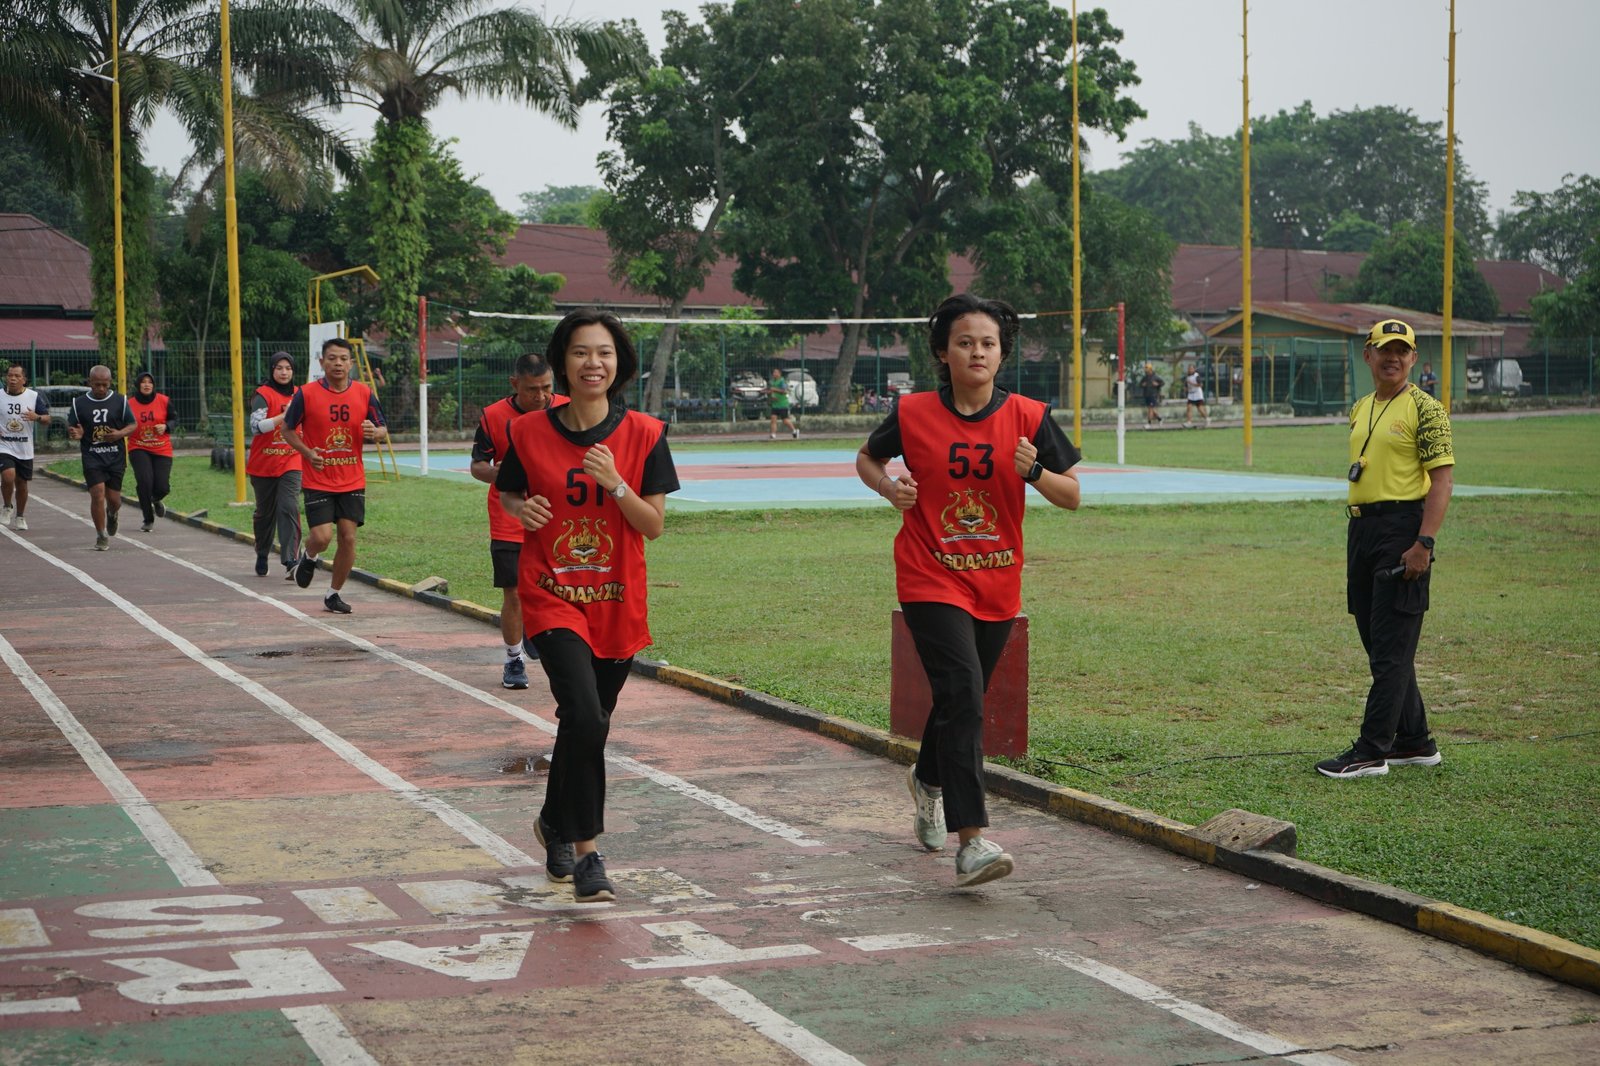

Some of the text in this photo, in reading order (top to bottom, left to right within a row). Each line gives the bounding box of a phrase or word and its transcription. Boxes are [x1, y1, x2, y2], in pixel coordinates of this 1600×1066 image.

[7, 403, 21, 415] 39
[92, 408, 109, 423] 27
[330, 404, 350, 422] 56
[140, 411, 155, 423] 54
[948, 442, 994, 480] 53
